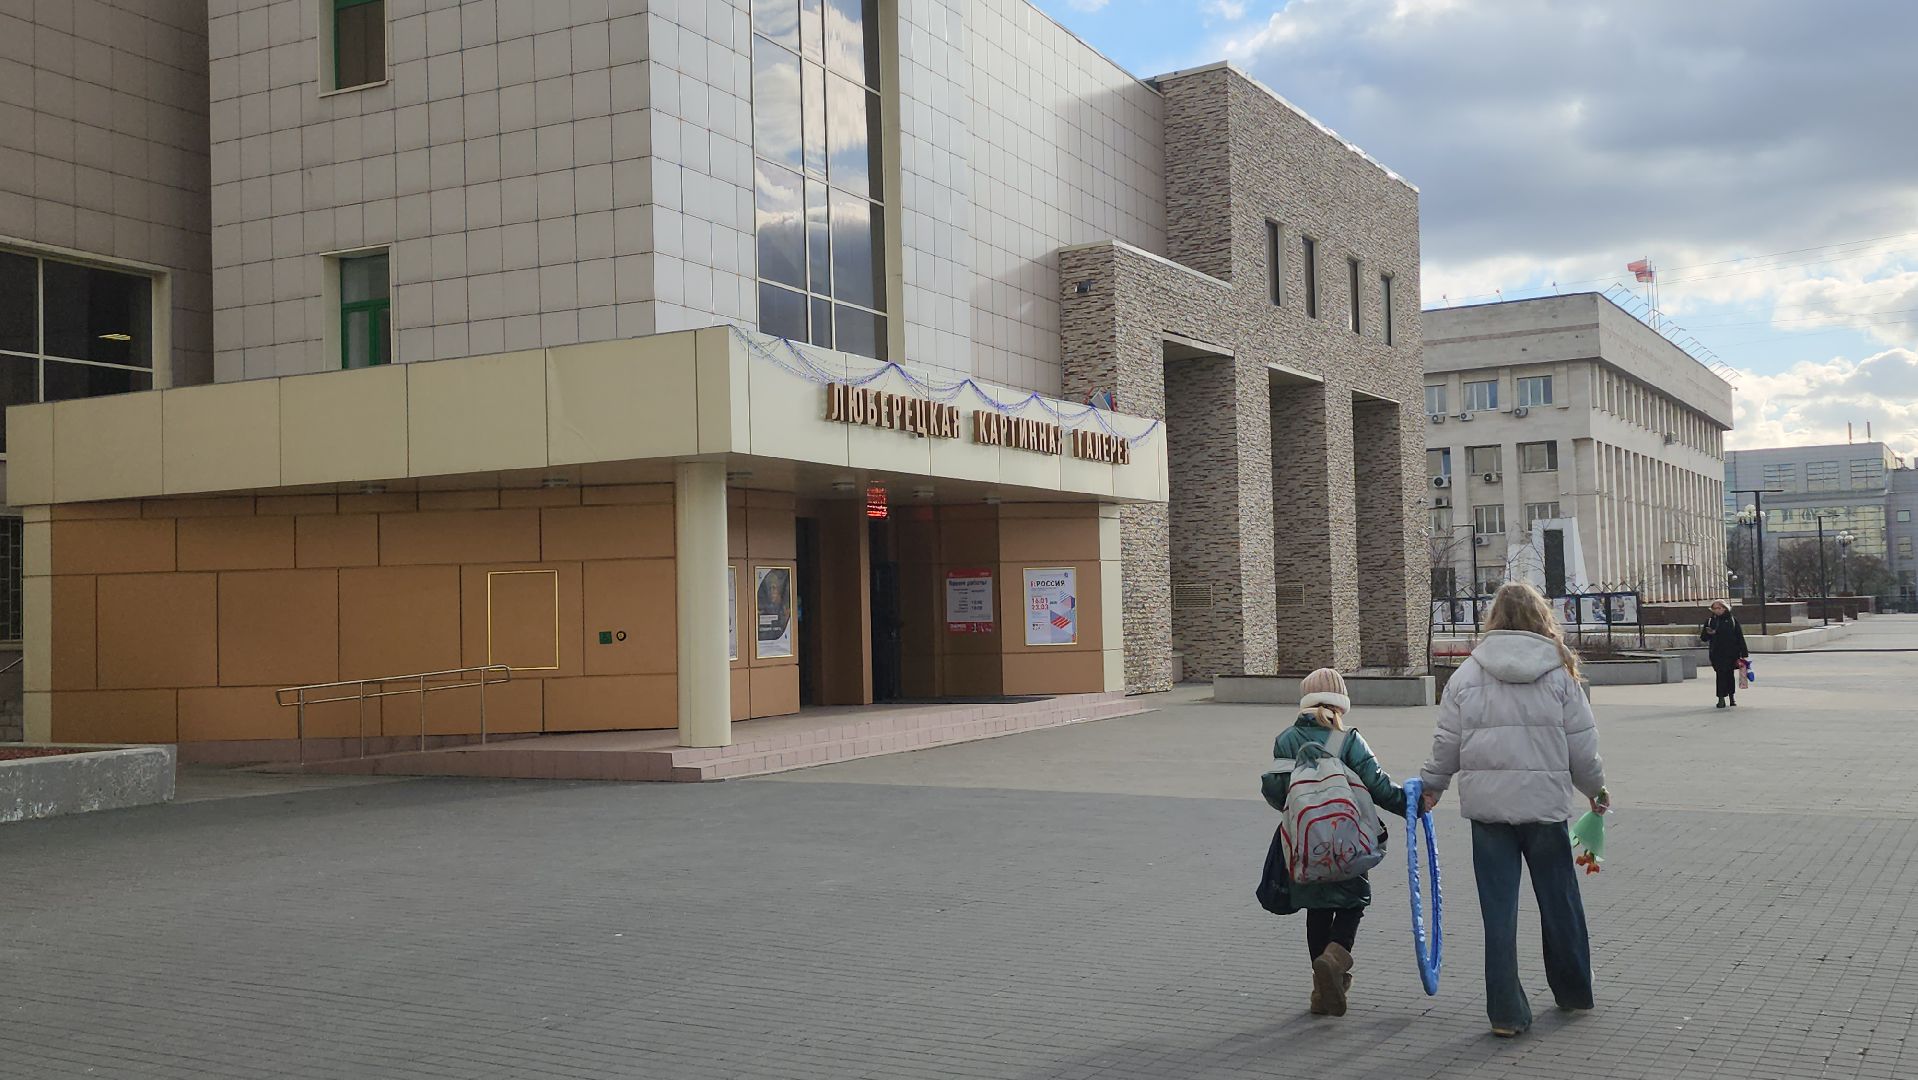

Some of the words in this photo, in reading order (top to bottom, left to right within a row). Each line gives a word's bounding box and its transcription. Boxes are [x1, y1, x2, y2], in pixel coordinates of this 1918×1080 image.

[826, 382, 960, 438] ЛЮБЕРЕЦКАЯ
[972, 410, 1062, 456] КАРТИННАЯ
[1072, 428, 1130, 465] ГАЛЕРЕЯ
